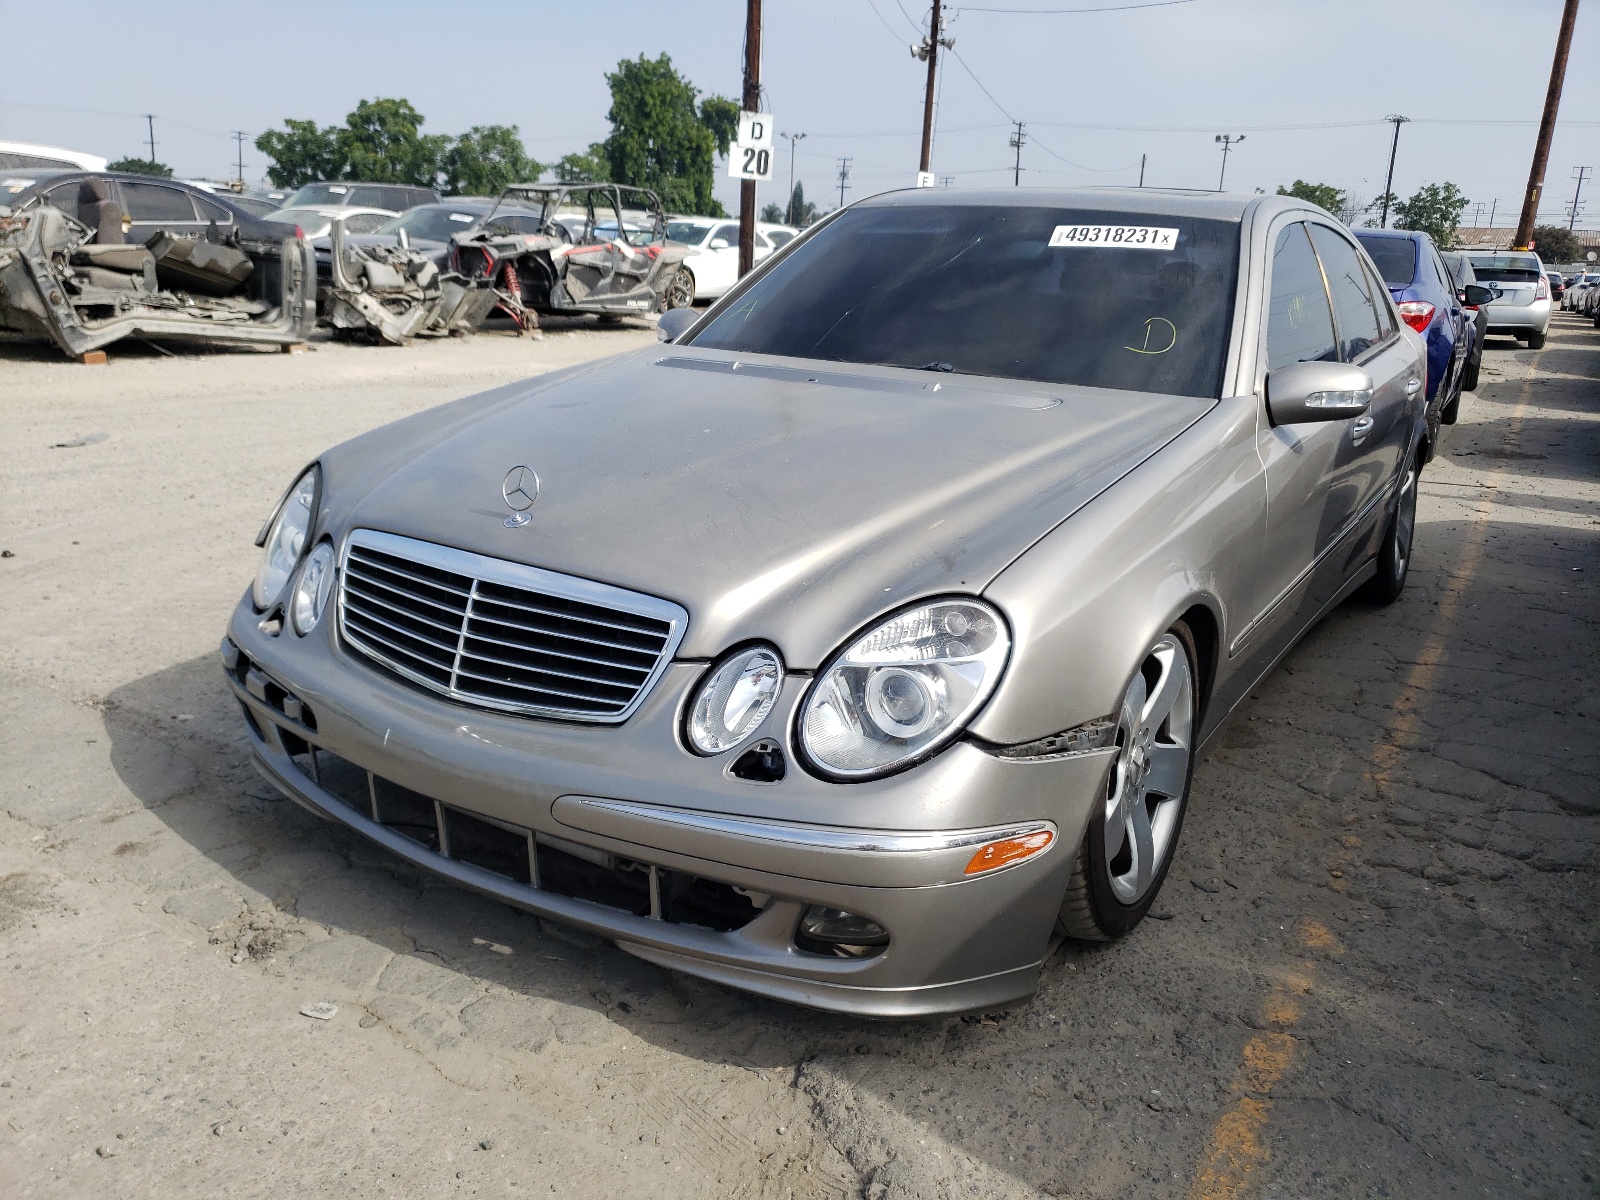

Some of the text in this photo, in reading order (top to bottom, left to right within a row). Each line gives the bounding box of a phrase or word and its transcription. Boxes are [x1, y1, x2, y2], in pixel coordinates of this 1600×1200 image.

[751, 122, 763, 140] D
[742, 148, 770, 176] 20
[1123, 317, 1177, 355] D
